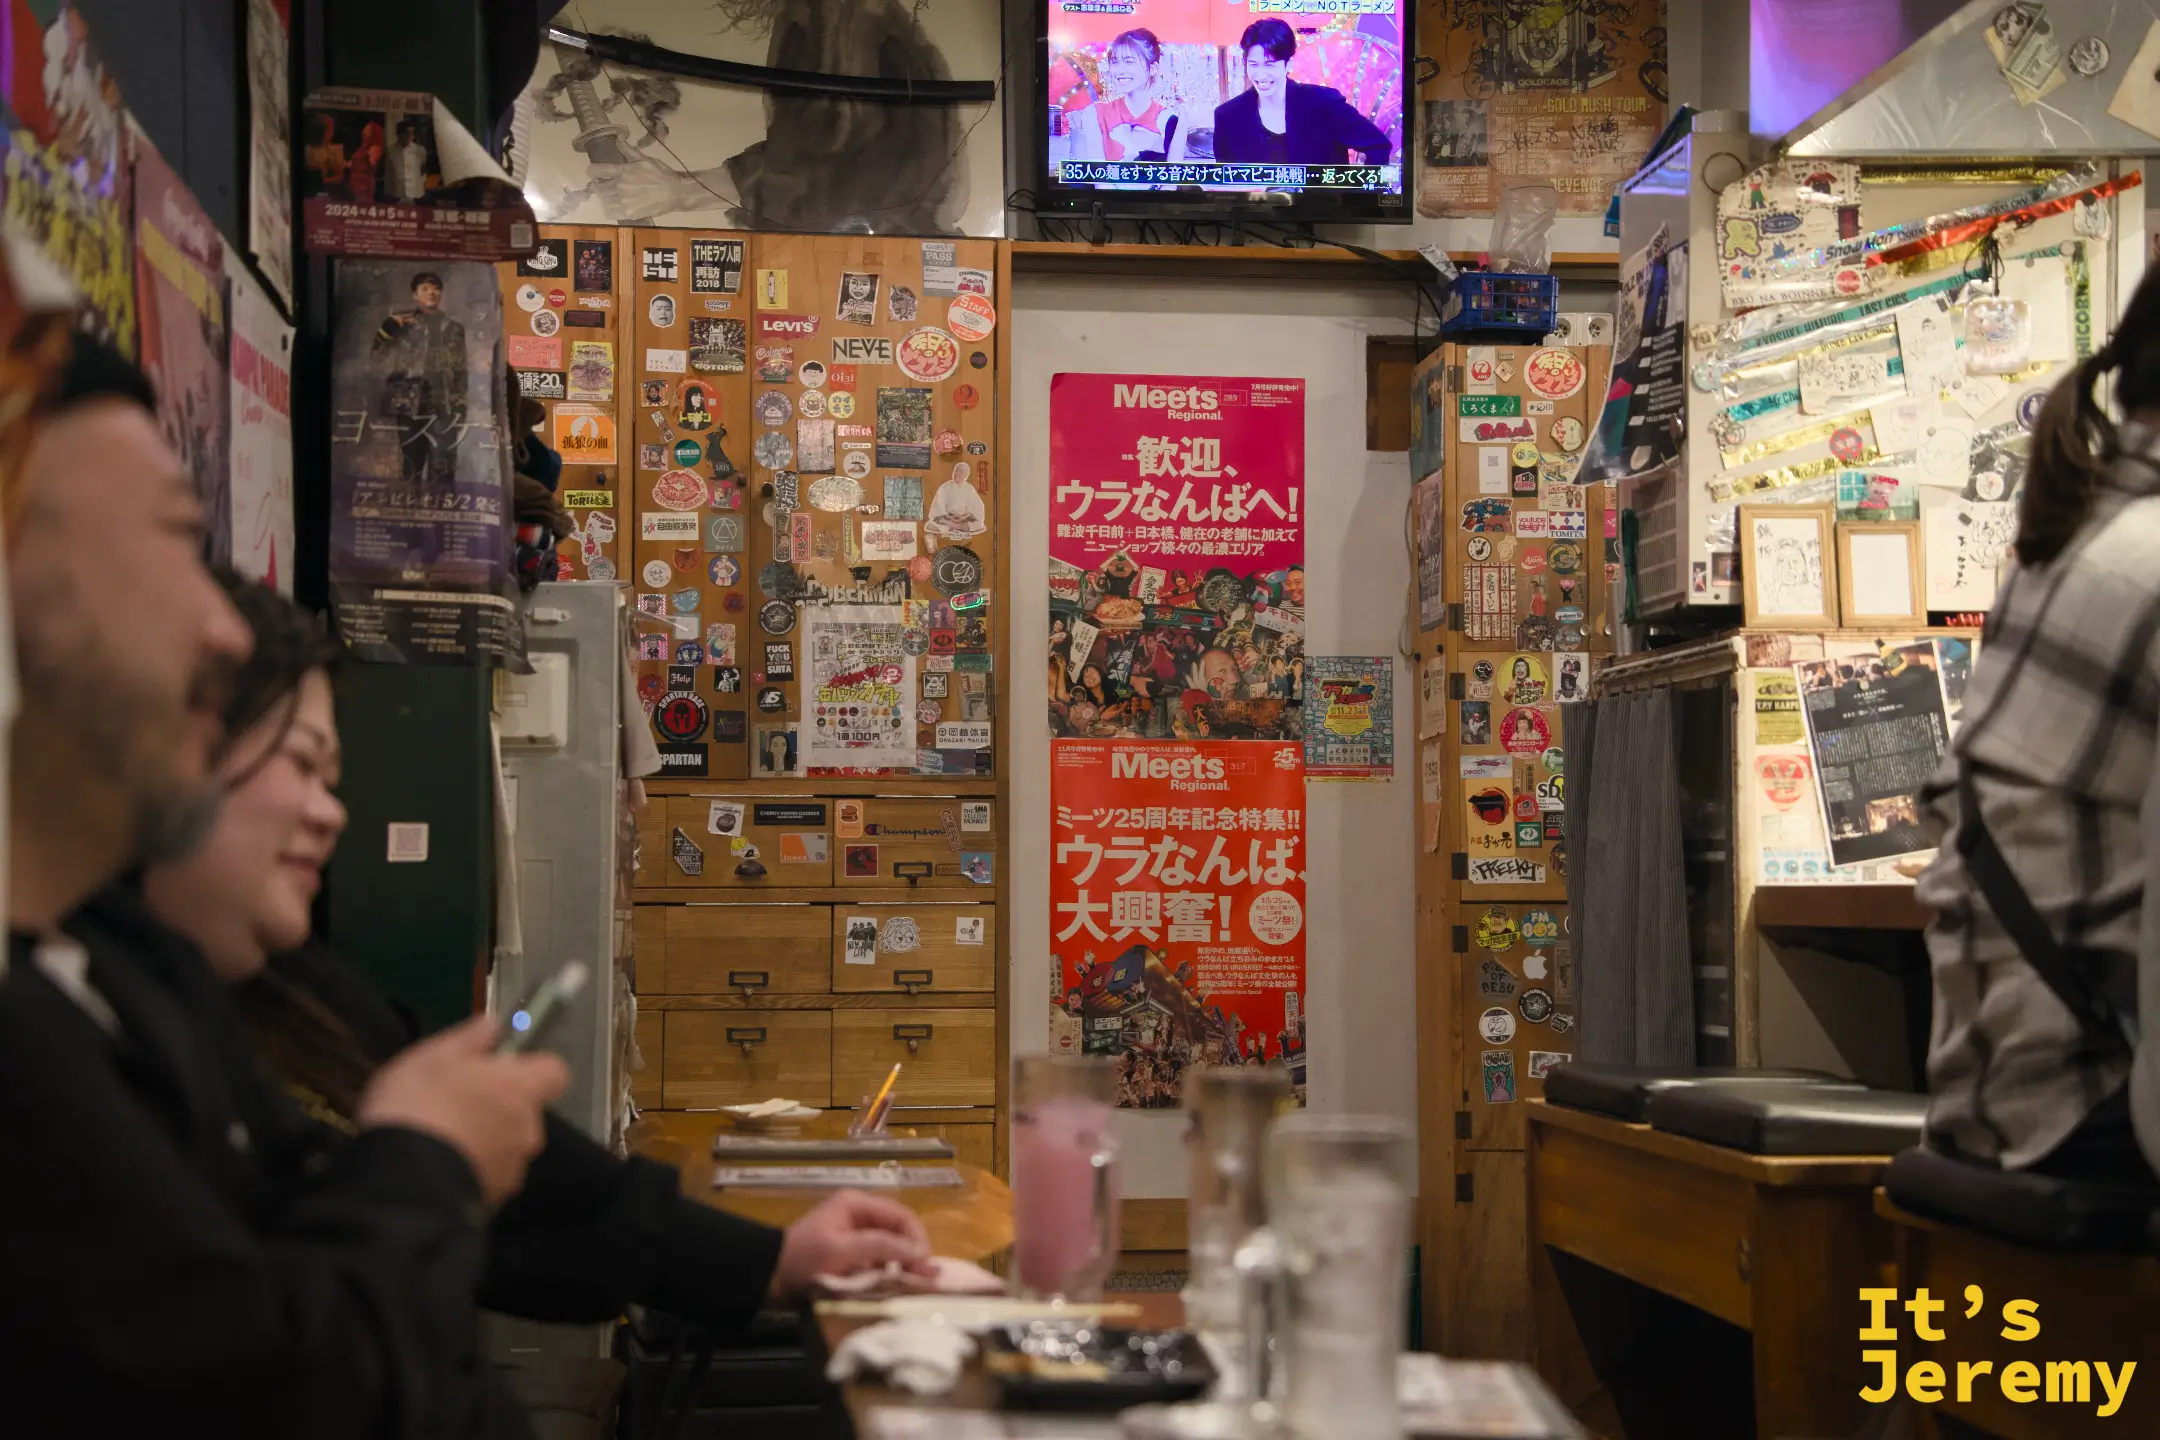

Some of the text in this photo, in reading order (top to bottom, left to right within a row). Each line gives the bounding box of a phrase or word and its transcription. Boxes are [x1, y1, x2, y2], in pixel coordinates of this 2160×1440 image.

[1518, 78, 1569, 86] GOLDCAGE
[925, 251, 953, 261] PASS
[696, 280, 720, 288] 2018
[959, 295, 990, 315] STAFF
[1113, 383, 1219, 410] Meets
[1223, 394, 1238, 402] 289
[1462, 403, 1497, 414] しろくま
[561, 435, 608, 449] 孤狼の血
[1136, 435, 1238, 478] 歓迎、
[1056, 480, 1298, 523] ウラなんばへ!
[1549, 530, 1584, 538] TOMITA
[766, 644, 790, 653] FUCK
[767, 665, 792, 674] SUITA
[671, 674, 690, 684] Help
[658, 692, 705, 709] SPARTAN RACE
[851, 732, 880, 741] 100円
[658, 753, 702, 766] SPARTAN
[1111, 752, 1225, 779] Meets
[1230, 762, 1246, 770] 317
[1463, 768, 1486, 776] peach
[1056, 805, 1300, 831] ミーツ25周年記念特集!!
[864, 823, 944, 840] Champion
[1055, 889, 1232, 943] 大興奮!
[1531, 912, 1550, 923] FM
